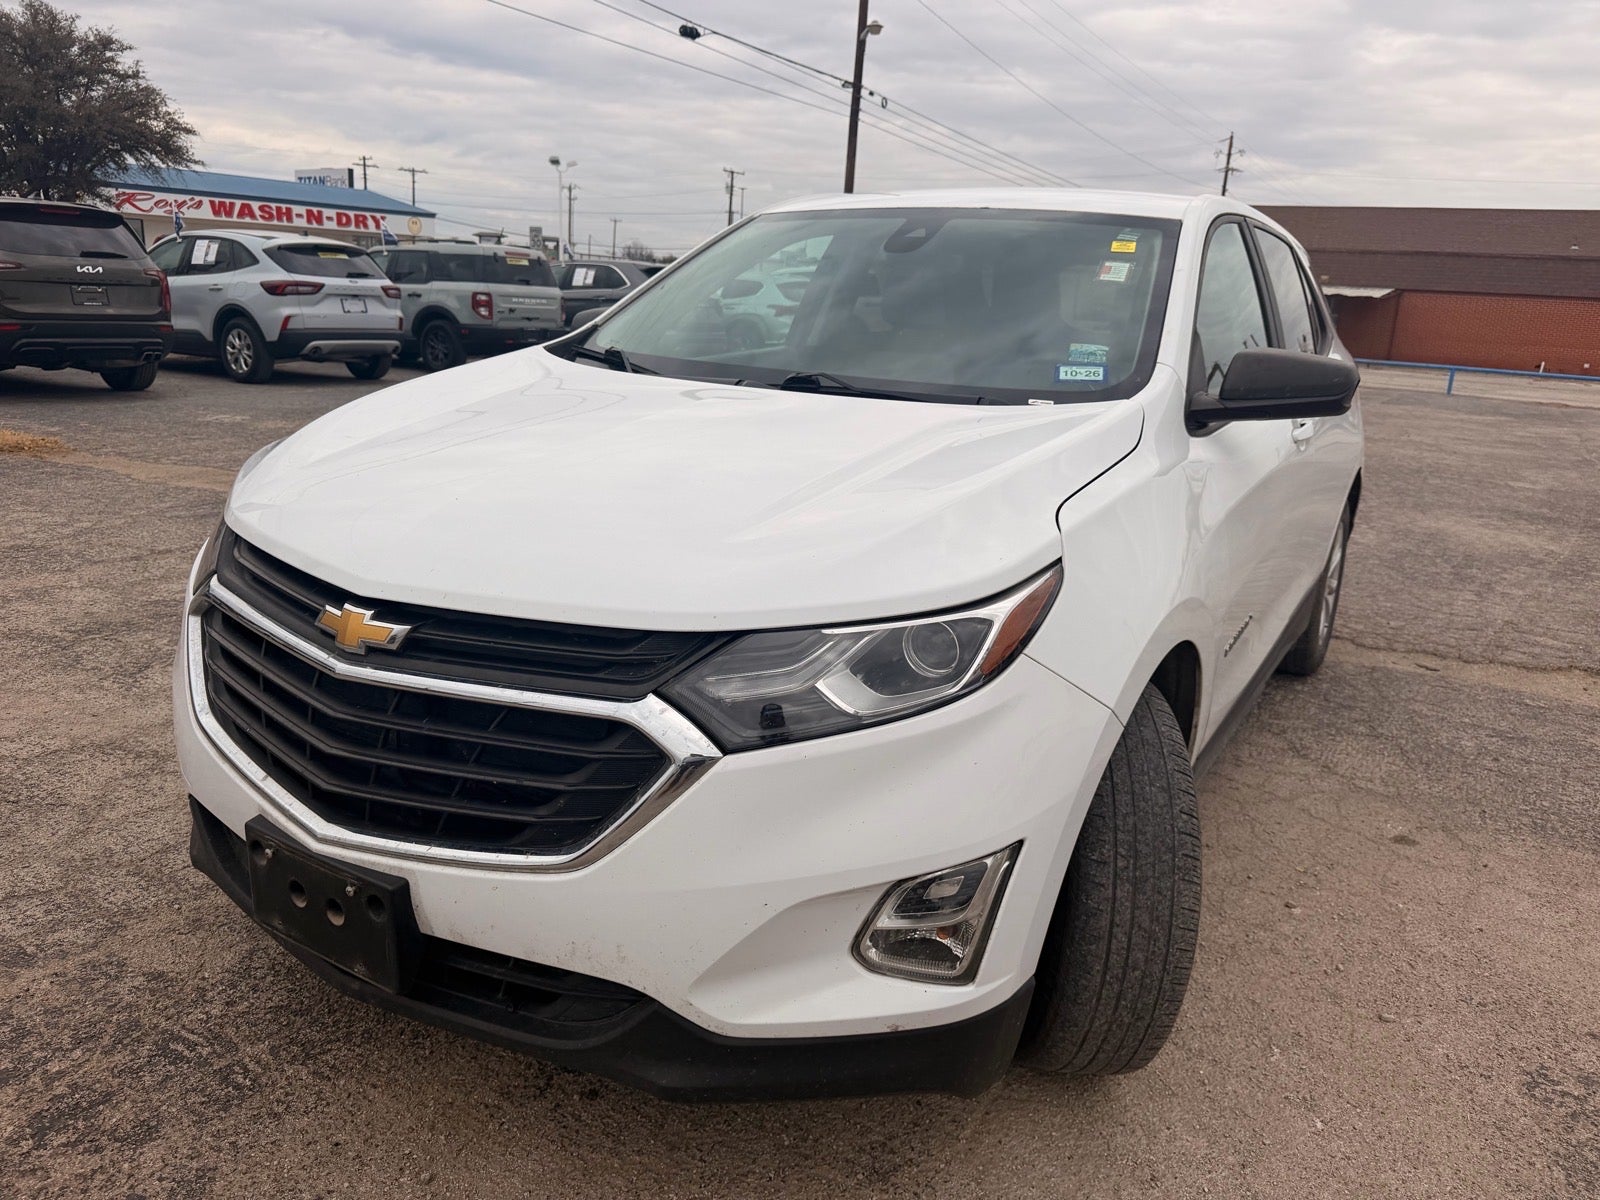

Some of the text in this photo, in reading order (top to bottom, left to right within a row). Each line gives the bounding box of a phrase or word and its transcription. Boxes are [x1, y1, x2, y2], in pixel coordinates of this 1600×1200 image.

[114, 191, 387, 230] Roy's WASH-N-DRY
[1084, 370, 1101, 378] 26
